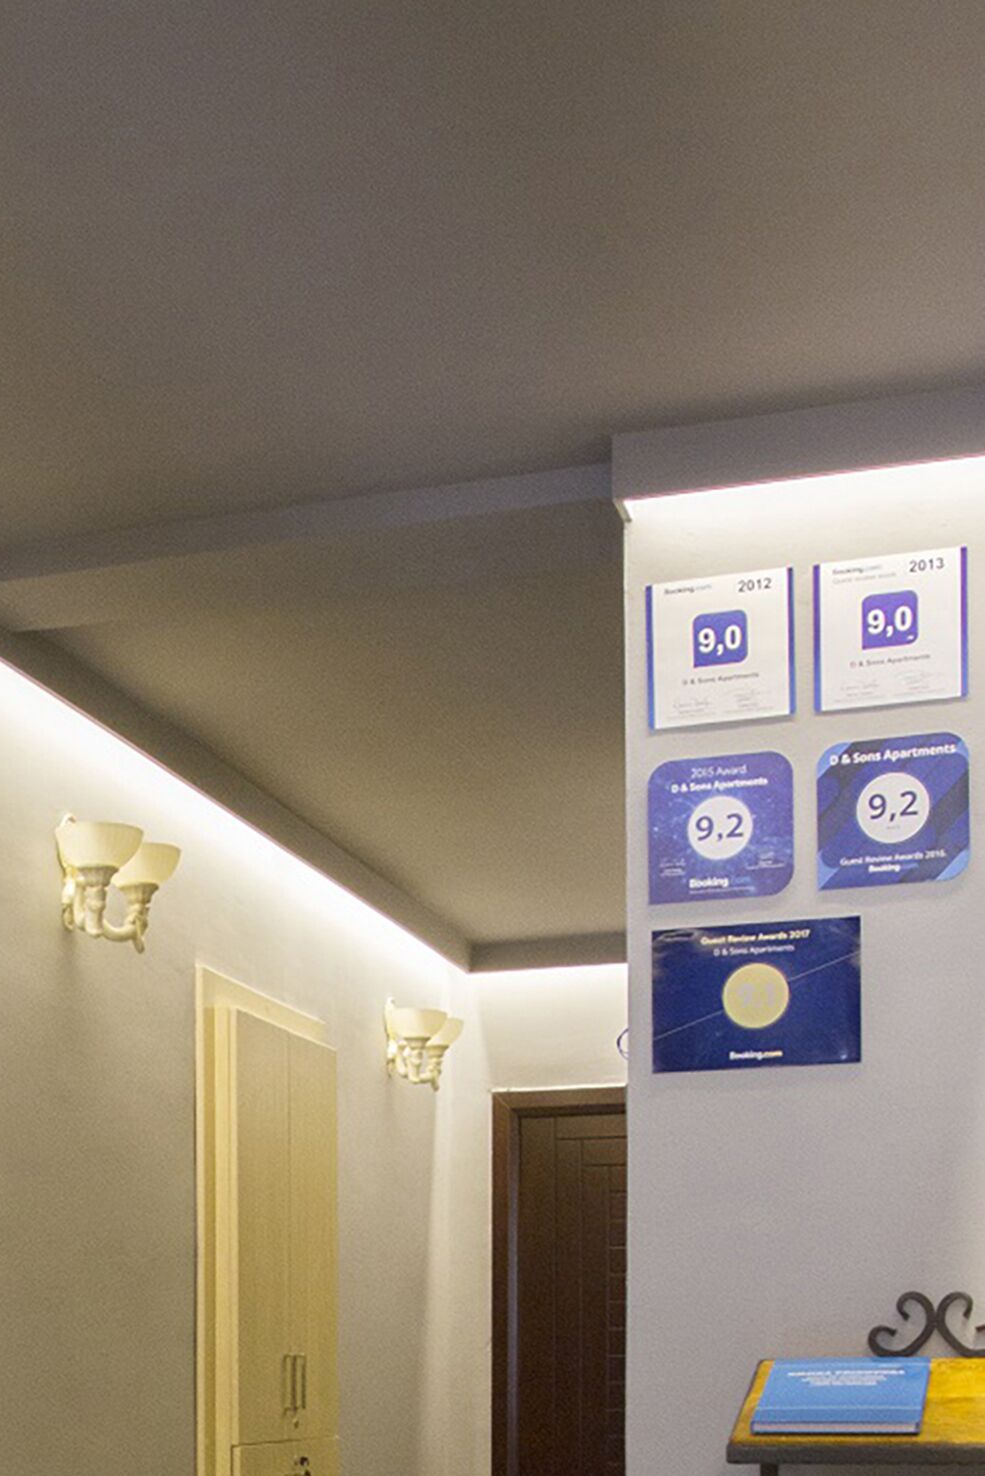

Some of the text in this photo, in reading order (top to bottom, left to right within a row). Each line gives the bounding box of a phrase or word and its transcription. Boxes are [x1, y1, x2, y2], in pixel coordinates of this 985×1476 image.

[909, 557, 944, 573] 2013
[738, 577, 772, 593] 2012
[867, 605, 914, 638] 9,0
[698, 624, 743, 656] 9,0
[829, 744, 957, 766] D & Sons Apartments
[714, 777, 769, 791] Apartments
[868, 790, 919, 822] 9,2
[695, 813, 744, 841] 9,2
